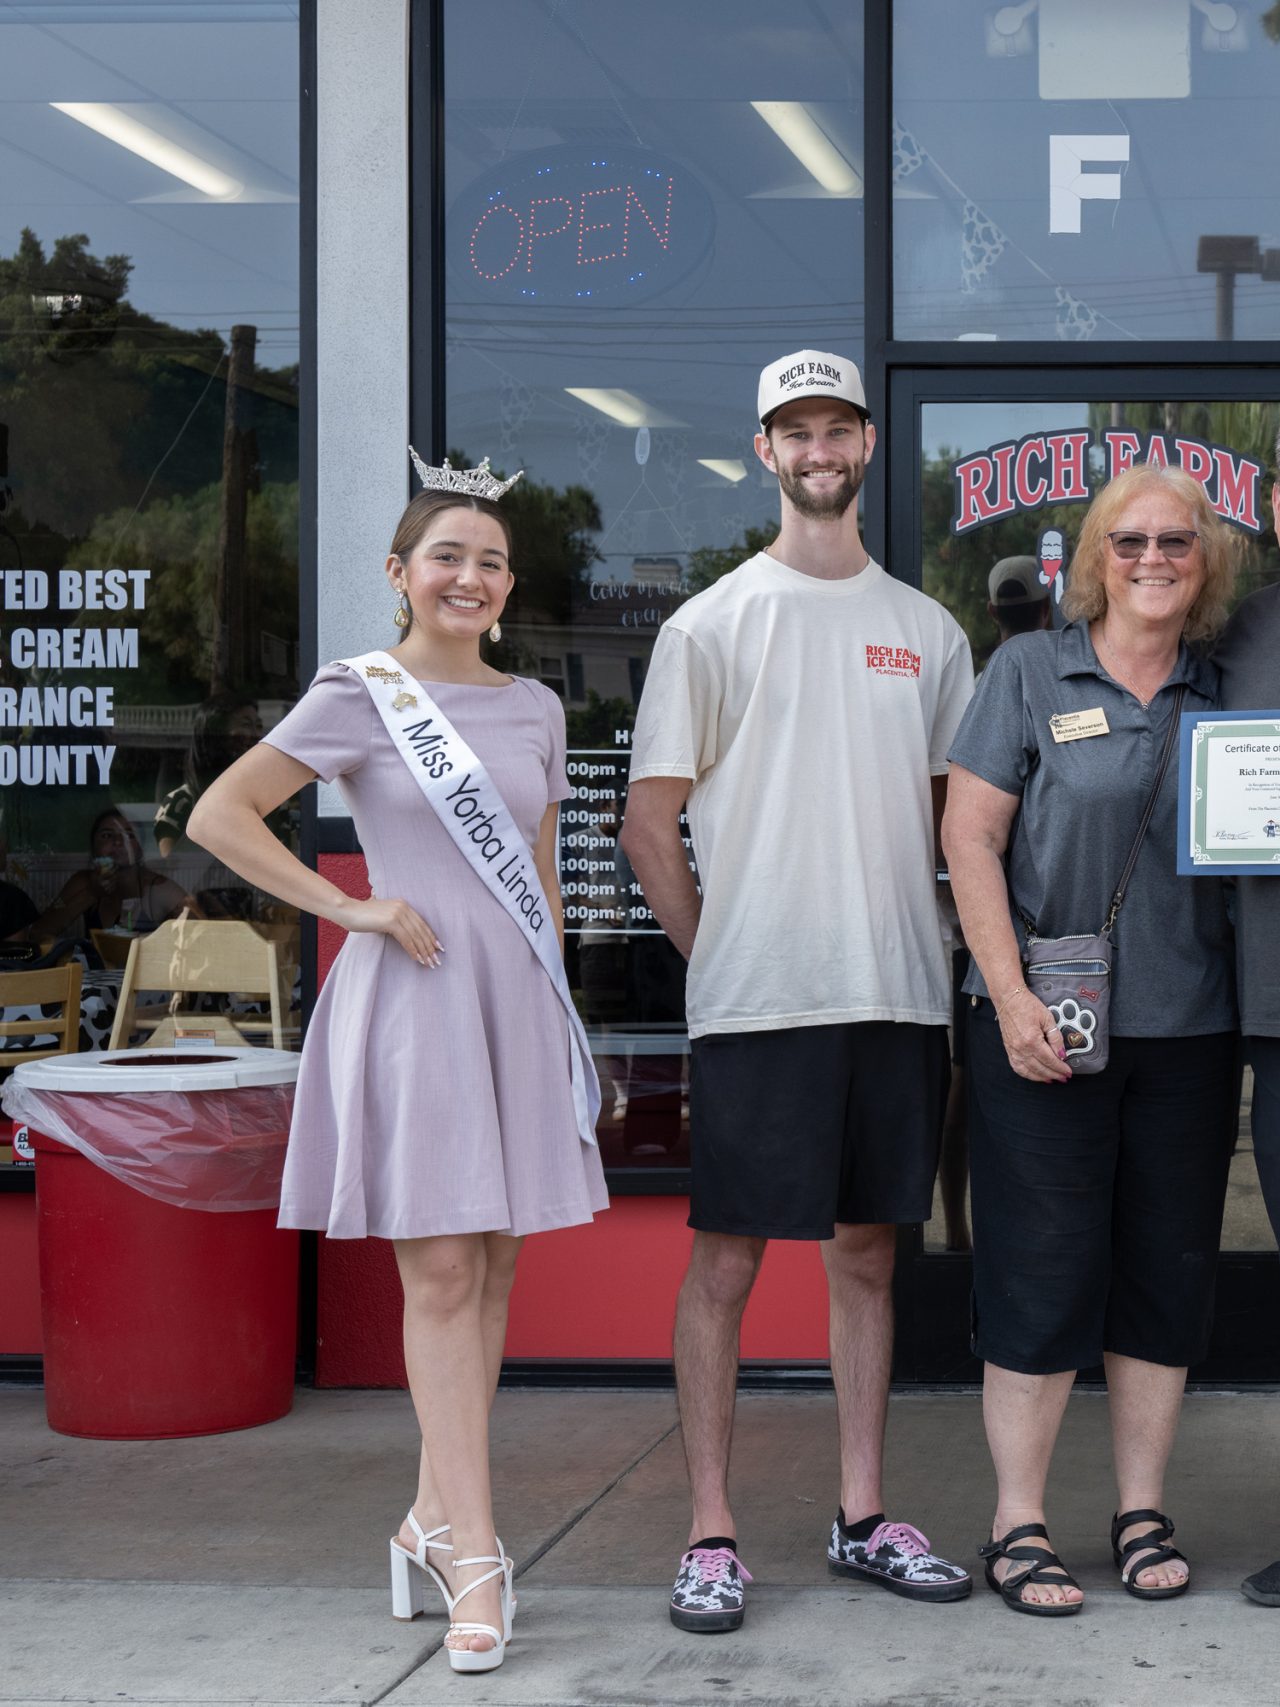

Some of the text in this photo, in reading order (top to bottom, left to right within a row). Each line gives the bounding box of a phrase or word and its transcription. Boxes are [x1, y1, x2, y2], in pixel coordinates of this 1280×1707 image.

[1050, 135, 1130, 233] F
[470, 177, 673, 279] OPEN
[778, 362, 842, 389] RICH FARM
[786, 377, 837, 392] Ice Cream
[956, 432, 1089, 531] RICH
[0, 569, 151, 611] ED BEST
[11, 628, 139, 669] CREAM
[865, 645, 921, 666] RICH FAM
[866, 656, 886, 668] ICE
[0, 686, 115, 728] RANGE
[1225, 743, 1271, 753] Certificate
[0, 745, 117, 786] OUNTY
[567, 762, 616, 779] 00pm
[1239, 768, 1257, 776] Rich
[1259, 768, 1280, 776] Farm
[402, 719, 544, 933] Miss Yorba Linda
[561, 810, 616, 827] :00pm
[561, 834, 616, 851] :00pm
[561, 858, 616, 875] :00pm
[561, 882, 616, 899] :00pm
[562, 906, 615, 922] :00pm
